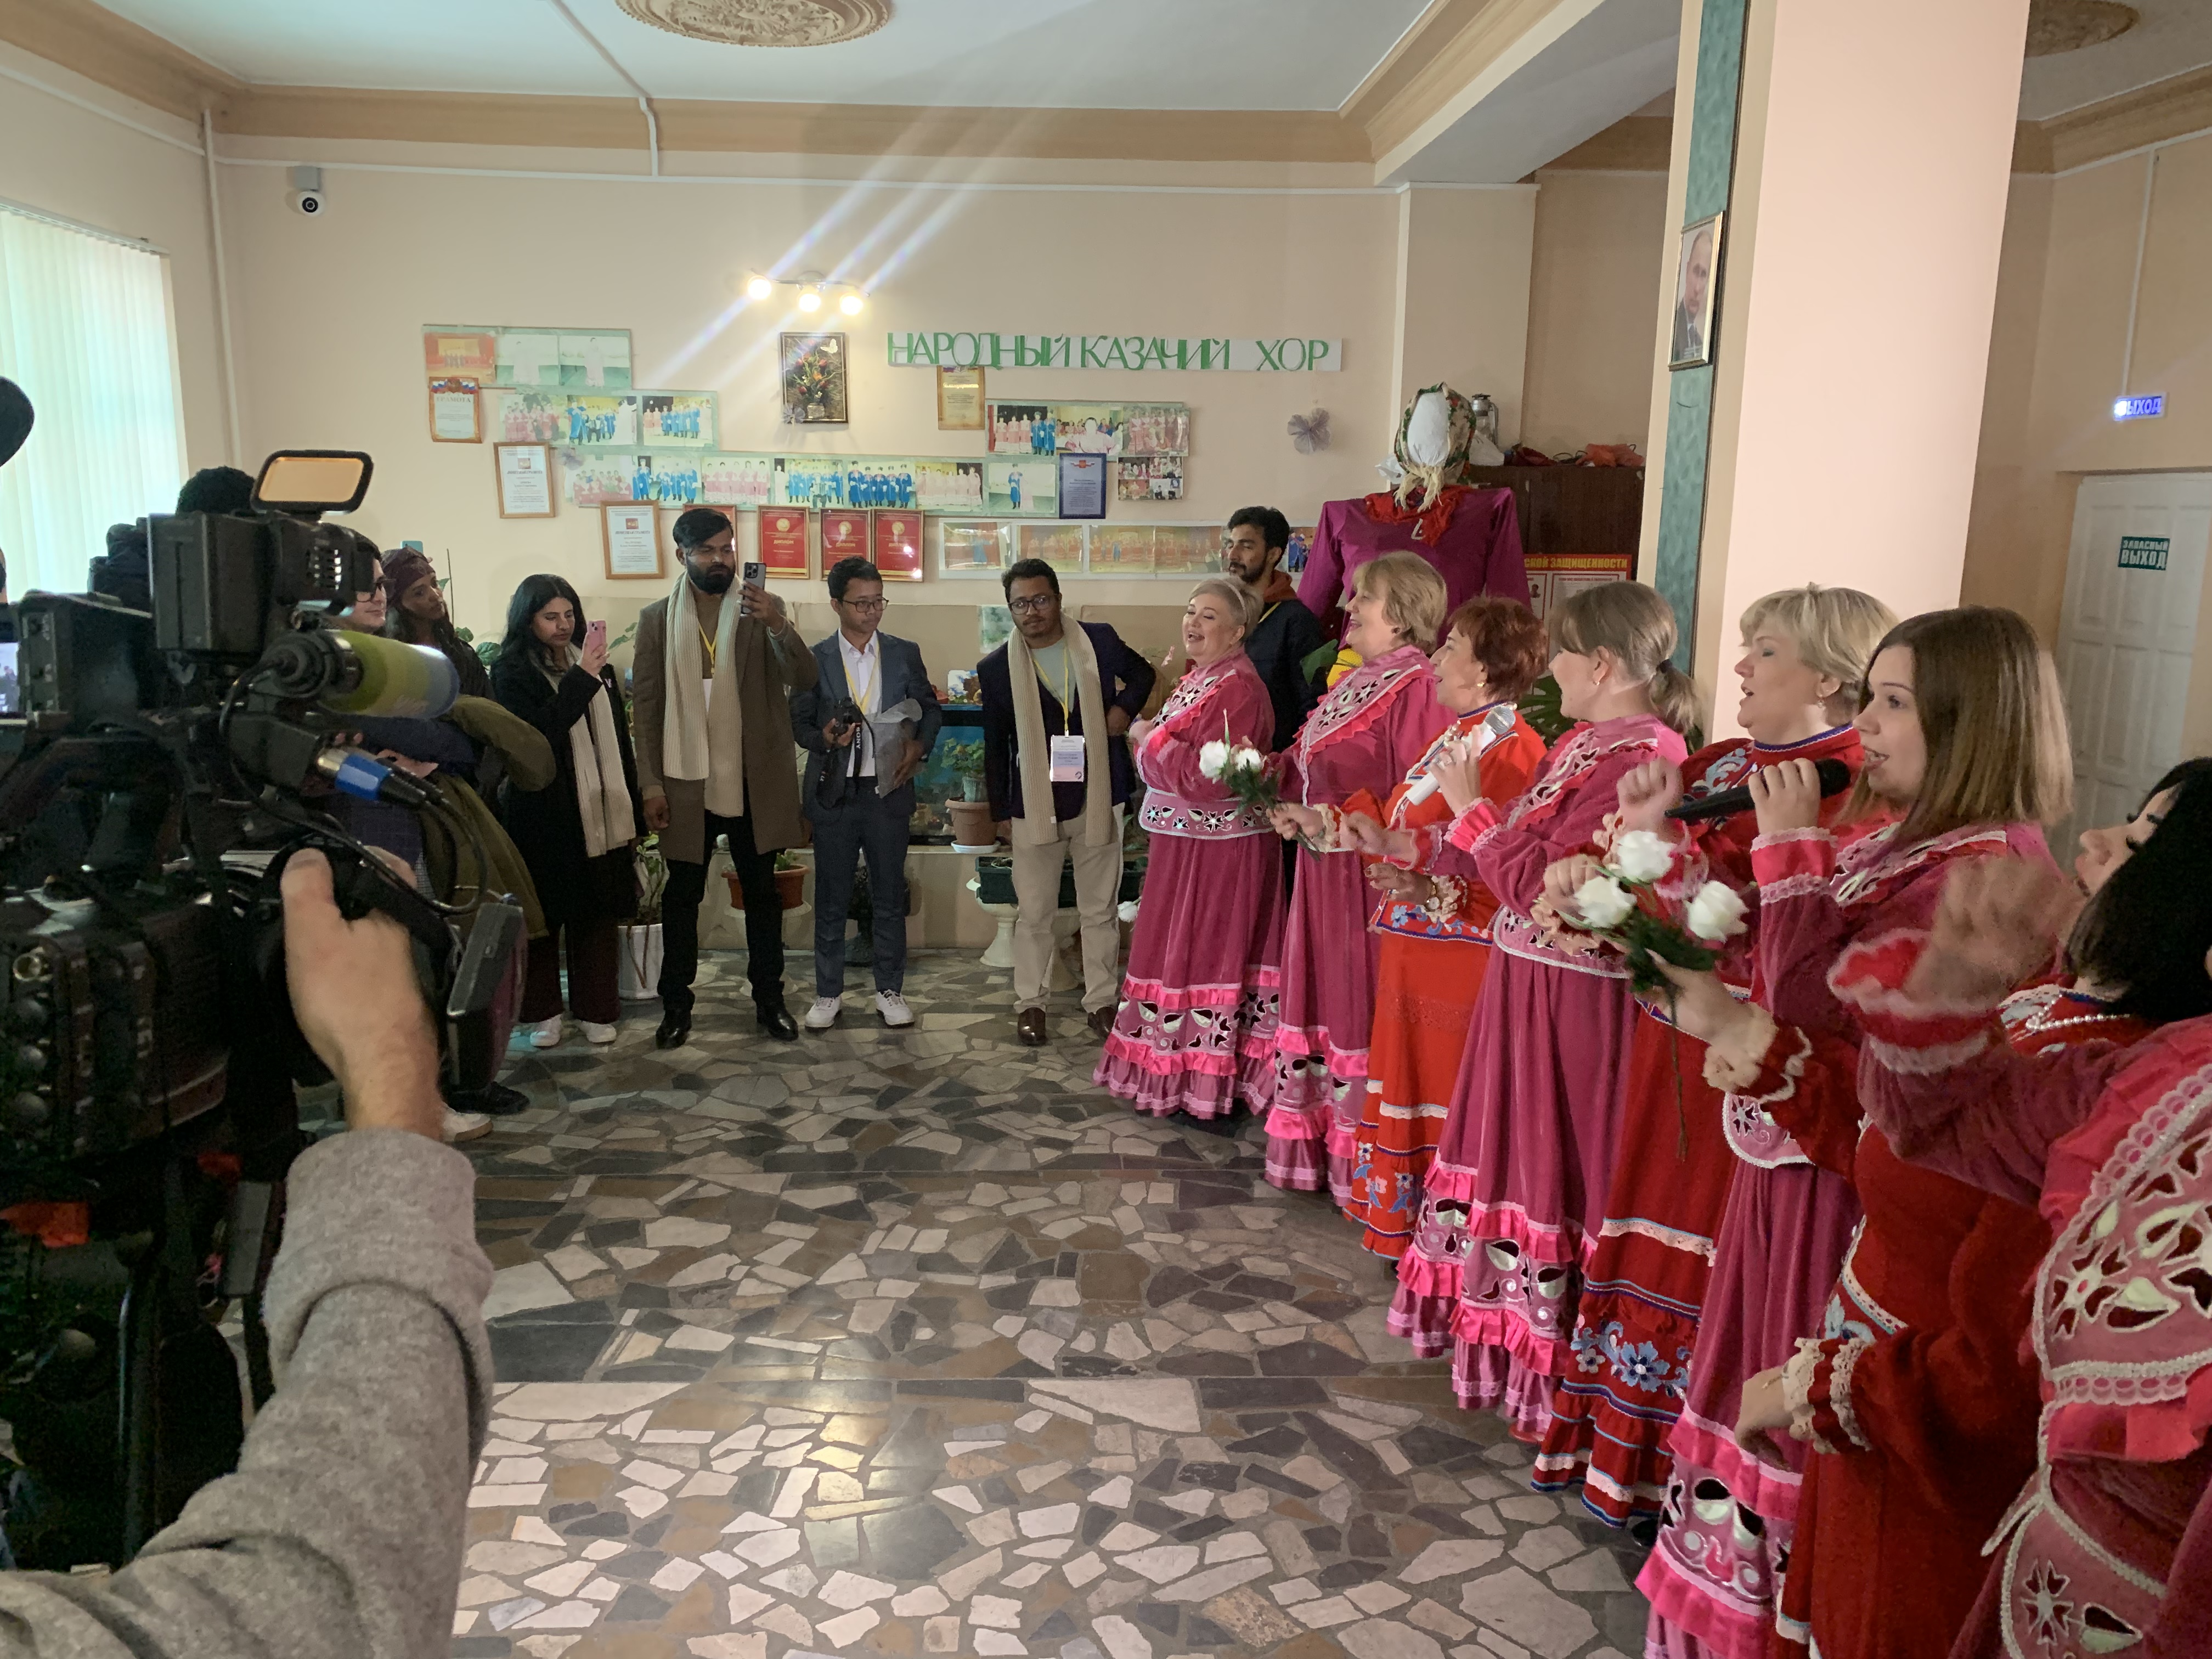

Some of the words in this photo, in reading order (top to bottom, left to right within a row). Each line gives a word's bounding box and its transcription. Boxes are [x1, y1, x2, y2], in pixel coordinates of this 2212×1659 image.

[887, 332, 1071, 370] НАРОДНЫЙ
[1081, 335, 1230, 371] КАЗАЧИЙ
[1255, 337, 1329, 371] ХОР
[2114, 398, 2162, 416] ЫХОД
[1524, 556, 1549, 568] СКОЙ
[2120, 549, 2166, 569] ВЫХОД
